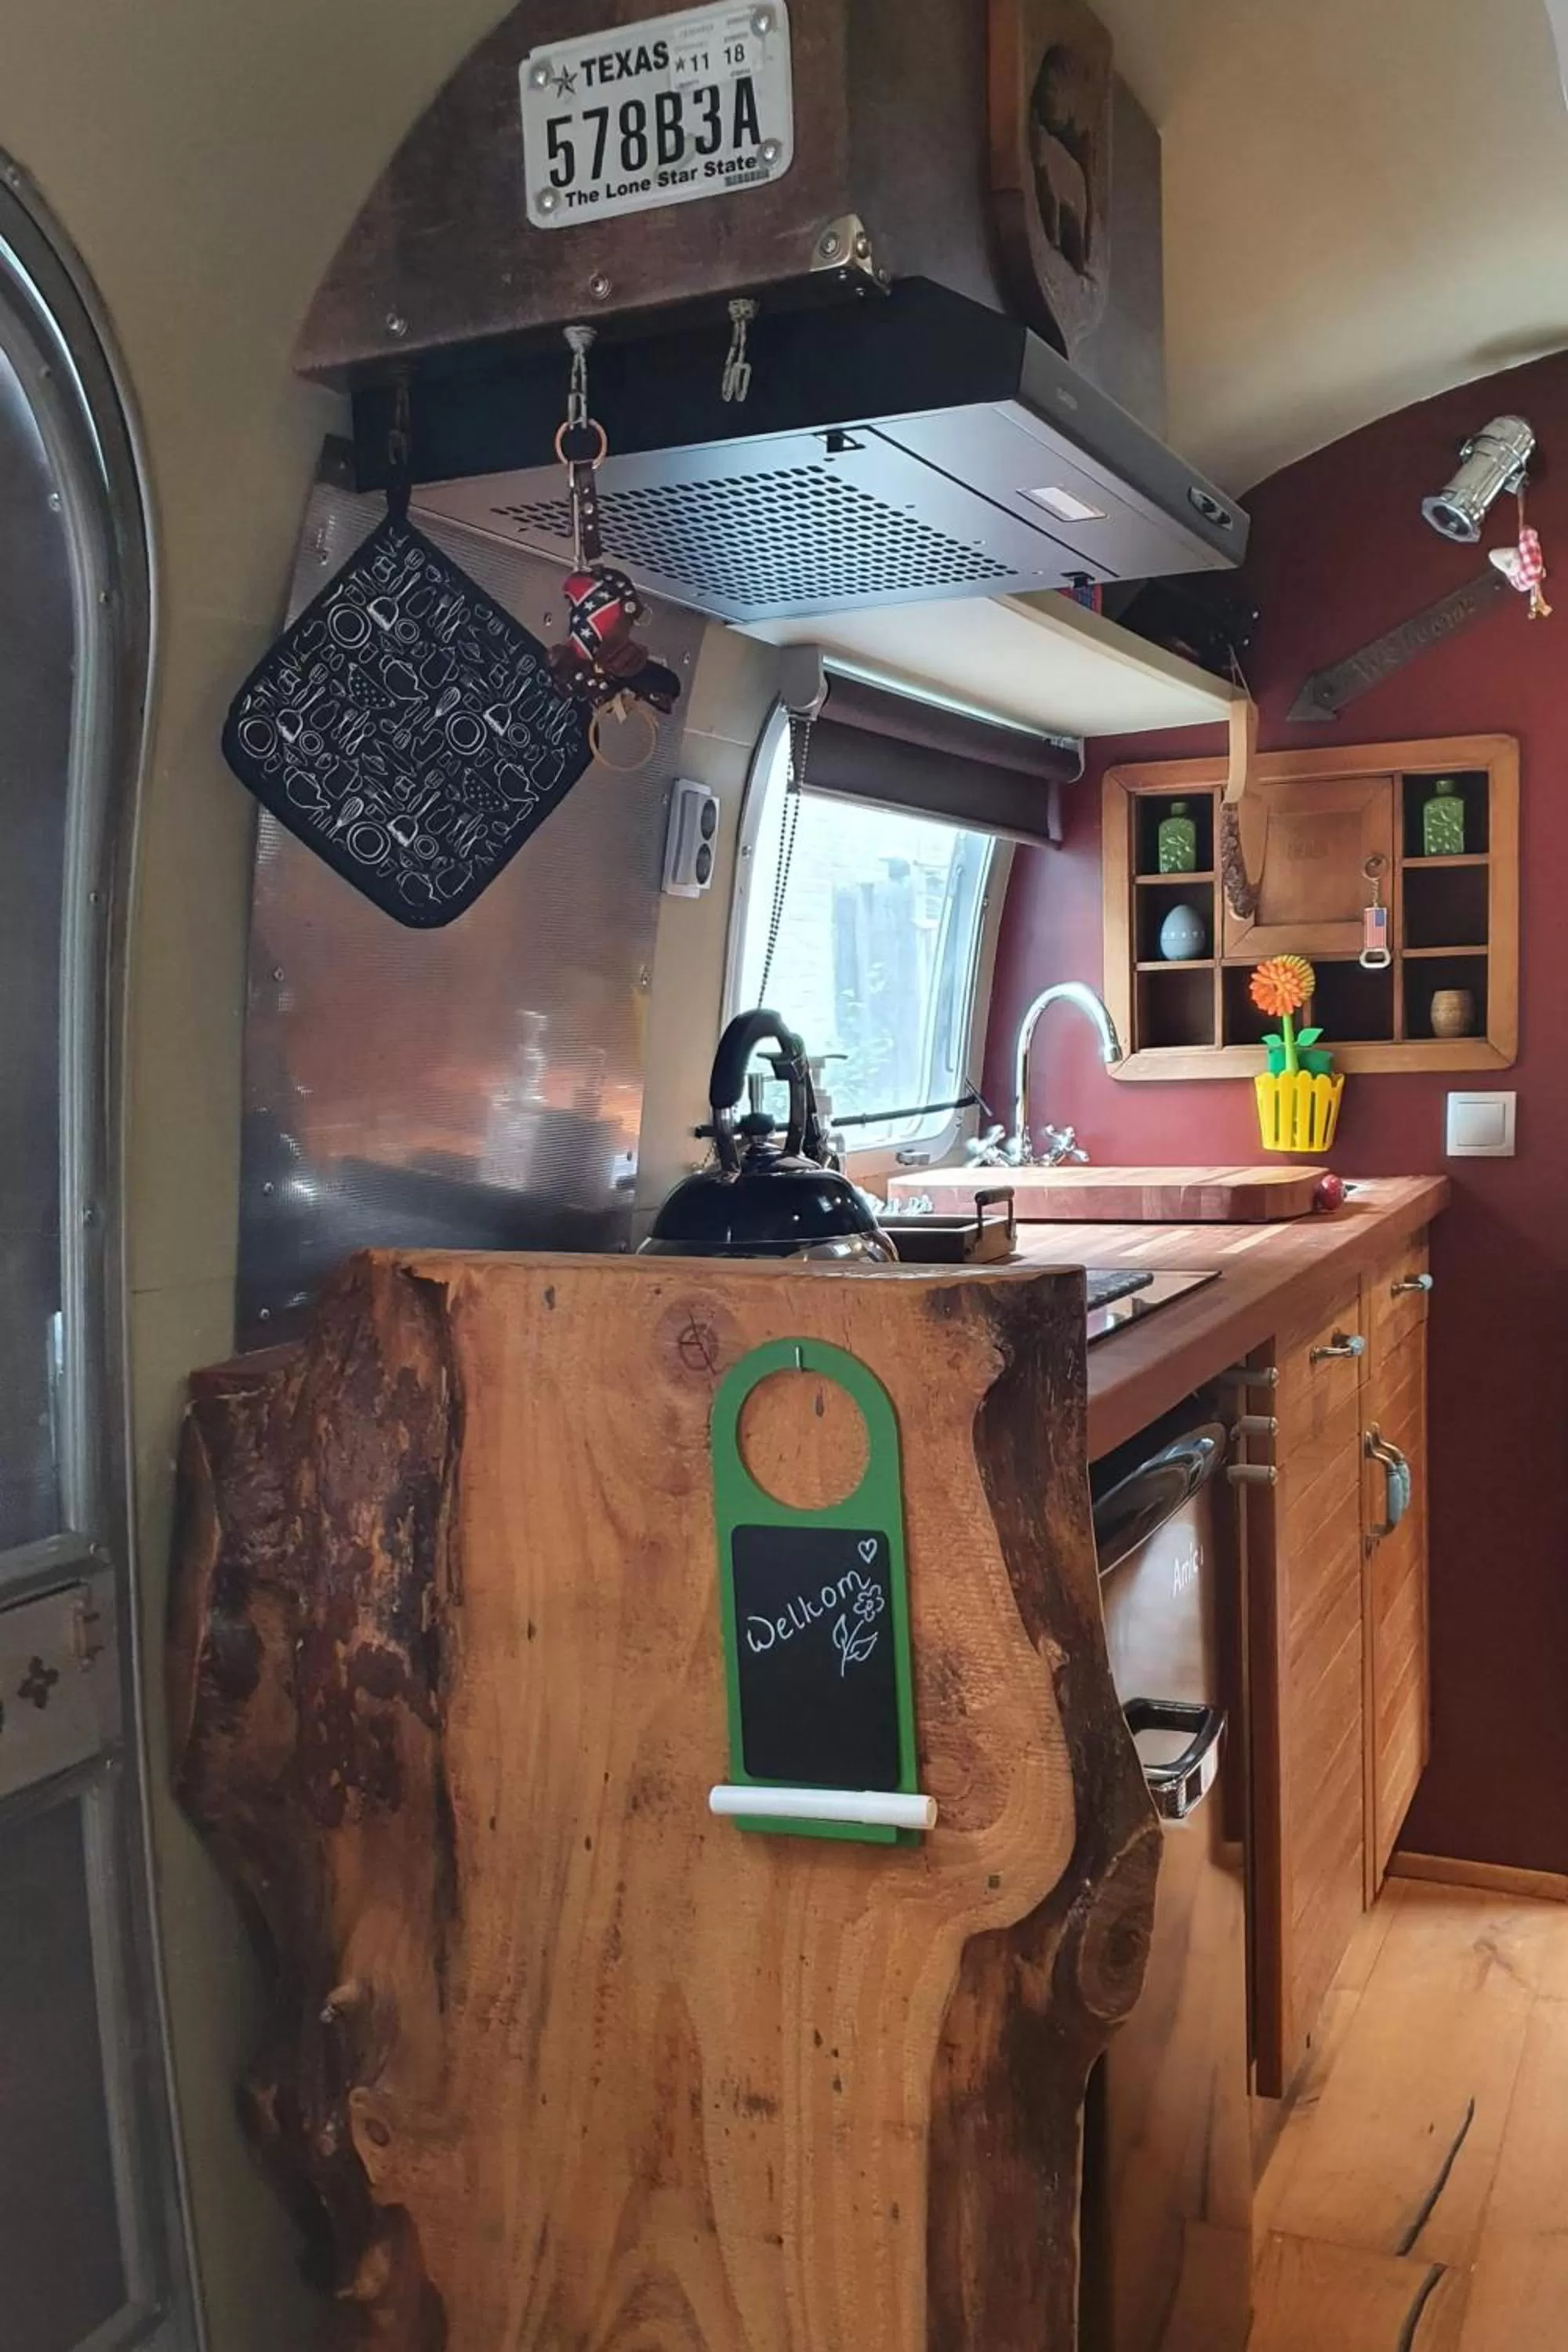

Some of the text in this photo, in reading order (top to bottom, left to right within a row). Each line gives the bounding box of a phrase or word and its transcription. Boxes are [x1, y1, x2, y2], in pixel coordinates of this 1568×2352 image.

[580, 41, 670, 87] TEXAS
[691, 53, 709, 72] 11
[724, 43, 745, 64] 18
[546, 76, 761, 188] 578B3A
[564, 191, 600, 208] The
[605, 179, 652, 199] Lone
[657, 165, 699, 187] Star
[703, 155, 757, 178] State
[746, 1570, 871, 1653] Welkom
